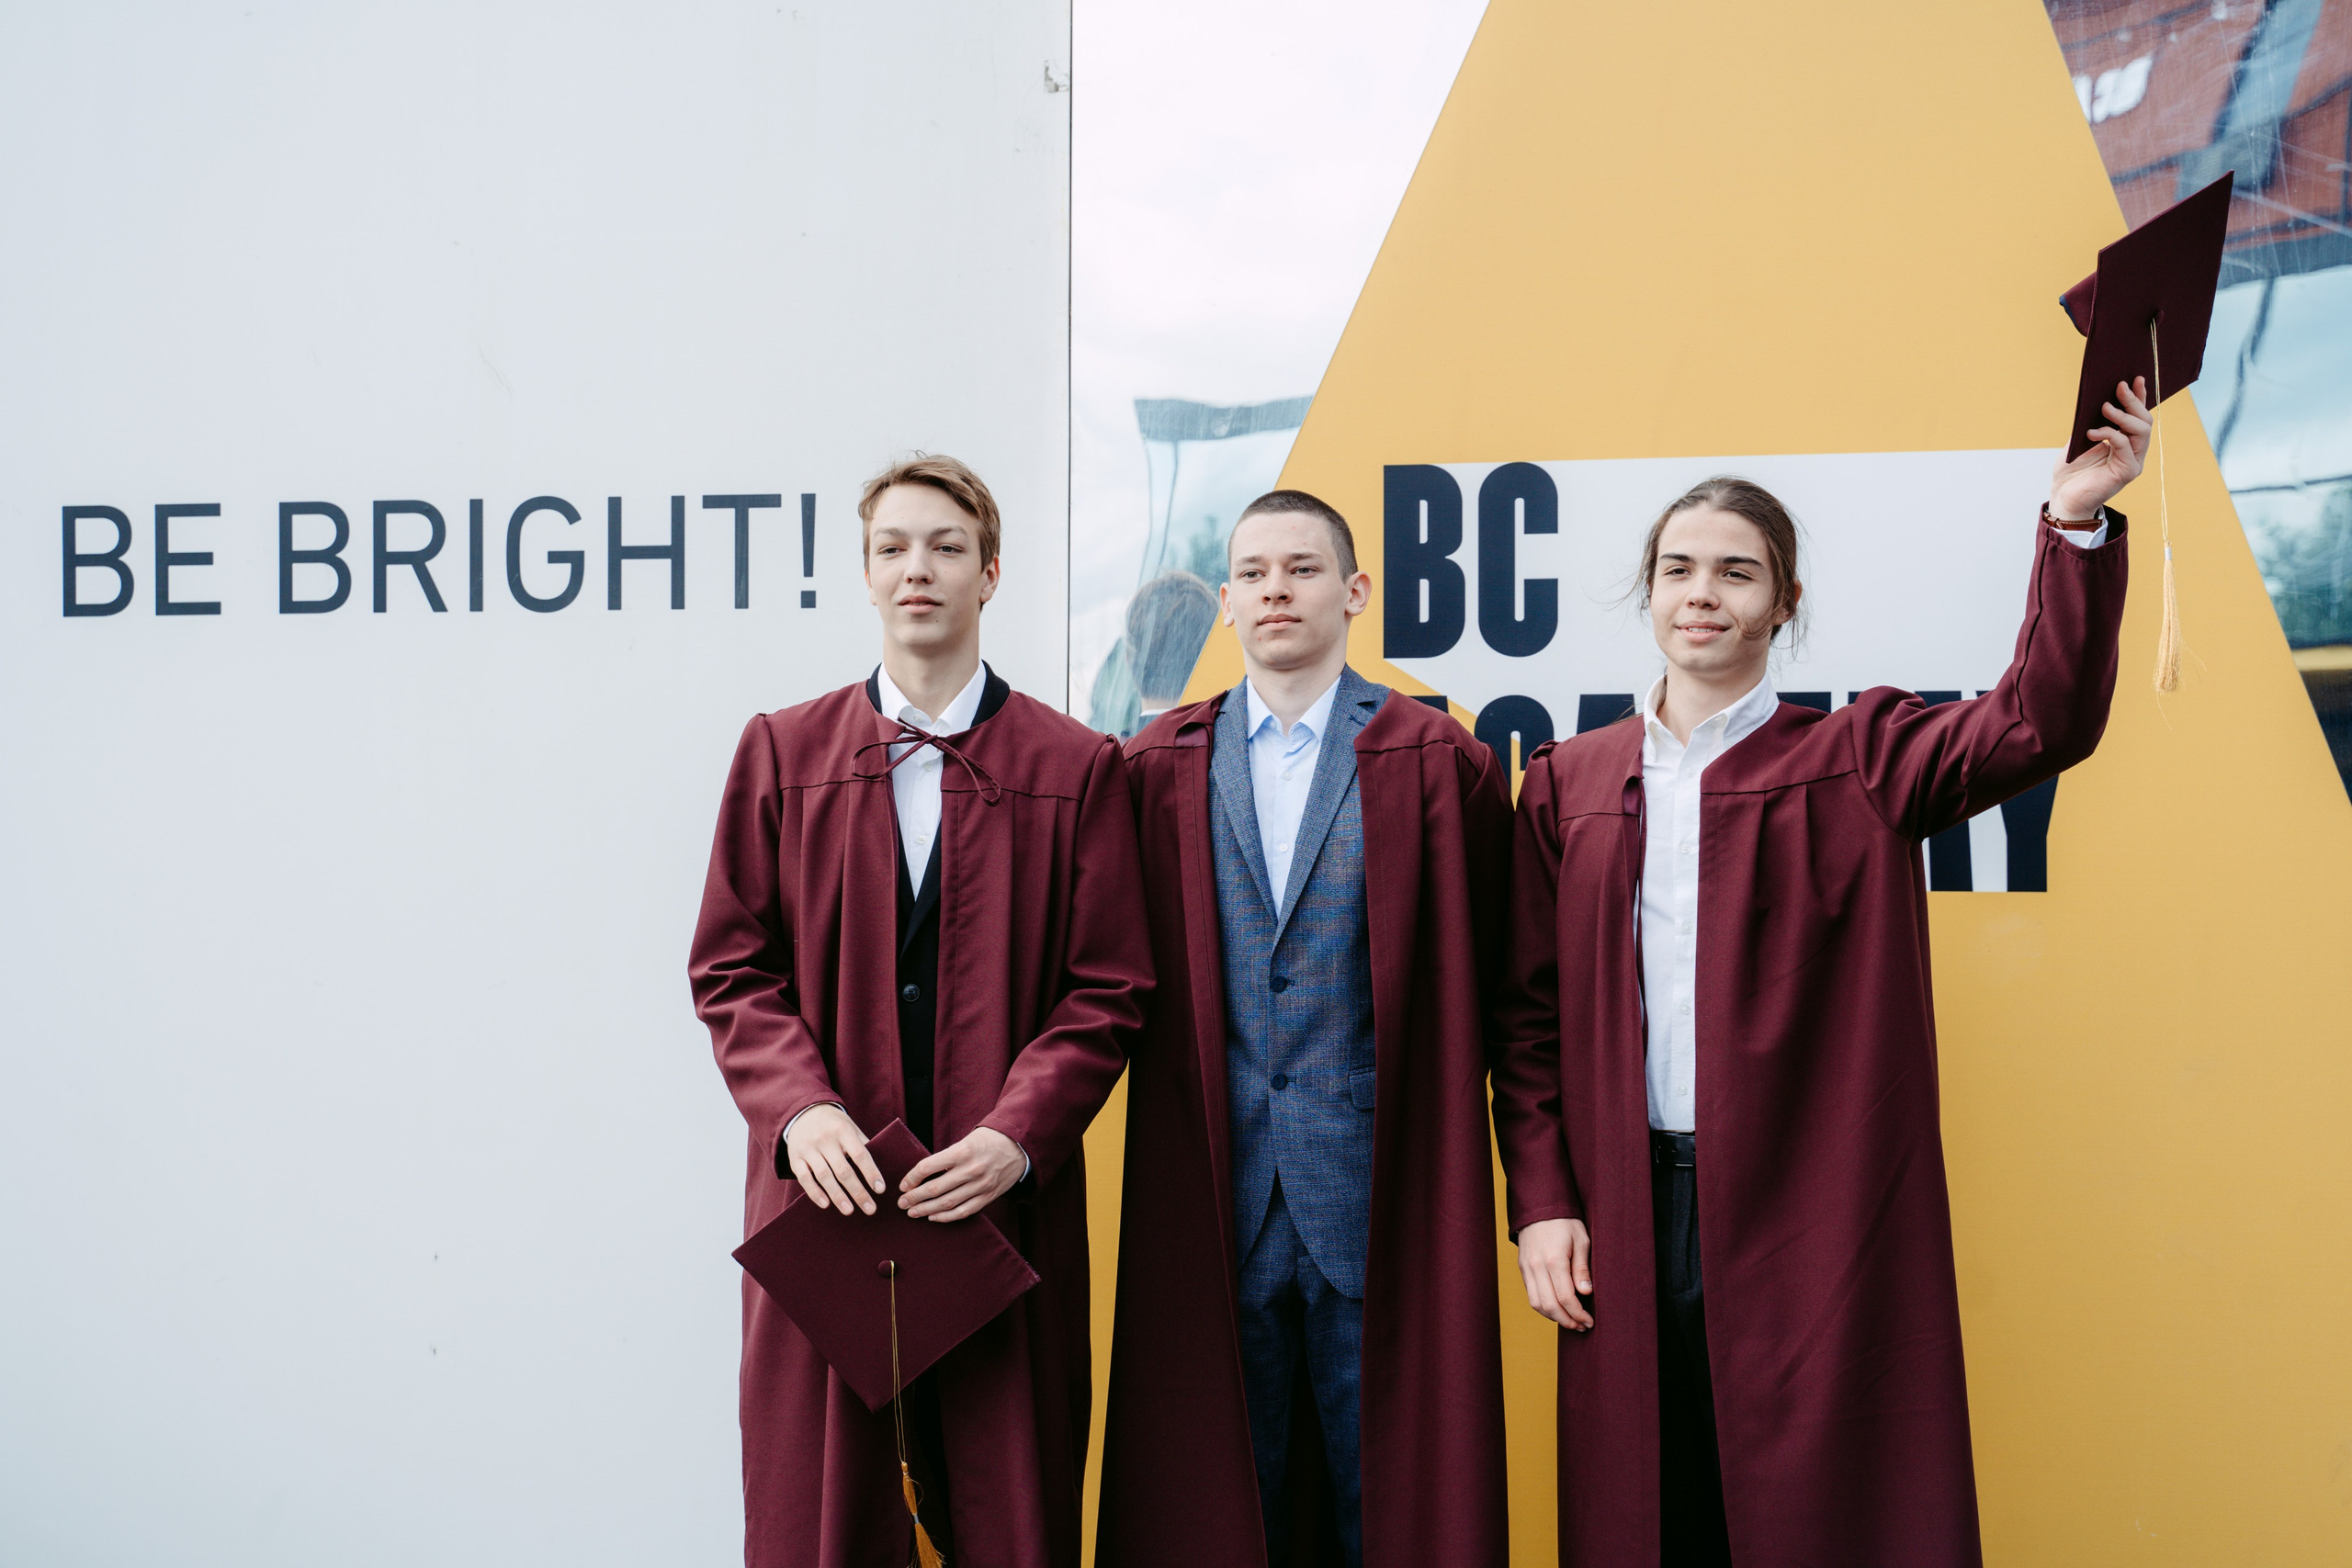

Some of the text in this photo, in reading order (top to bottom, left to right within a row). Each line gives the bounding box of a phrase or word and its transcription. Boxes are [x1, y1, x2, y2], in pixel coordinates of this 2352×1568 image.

[62, 492, 817, 618] BE BRIGHT!
[1383, 461, 1559, 660] BC
